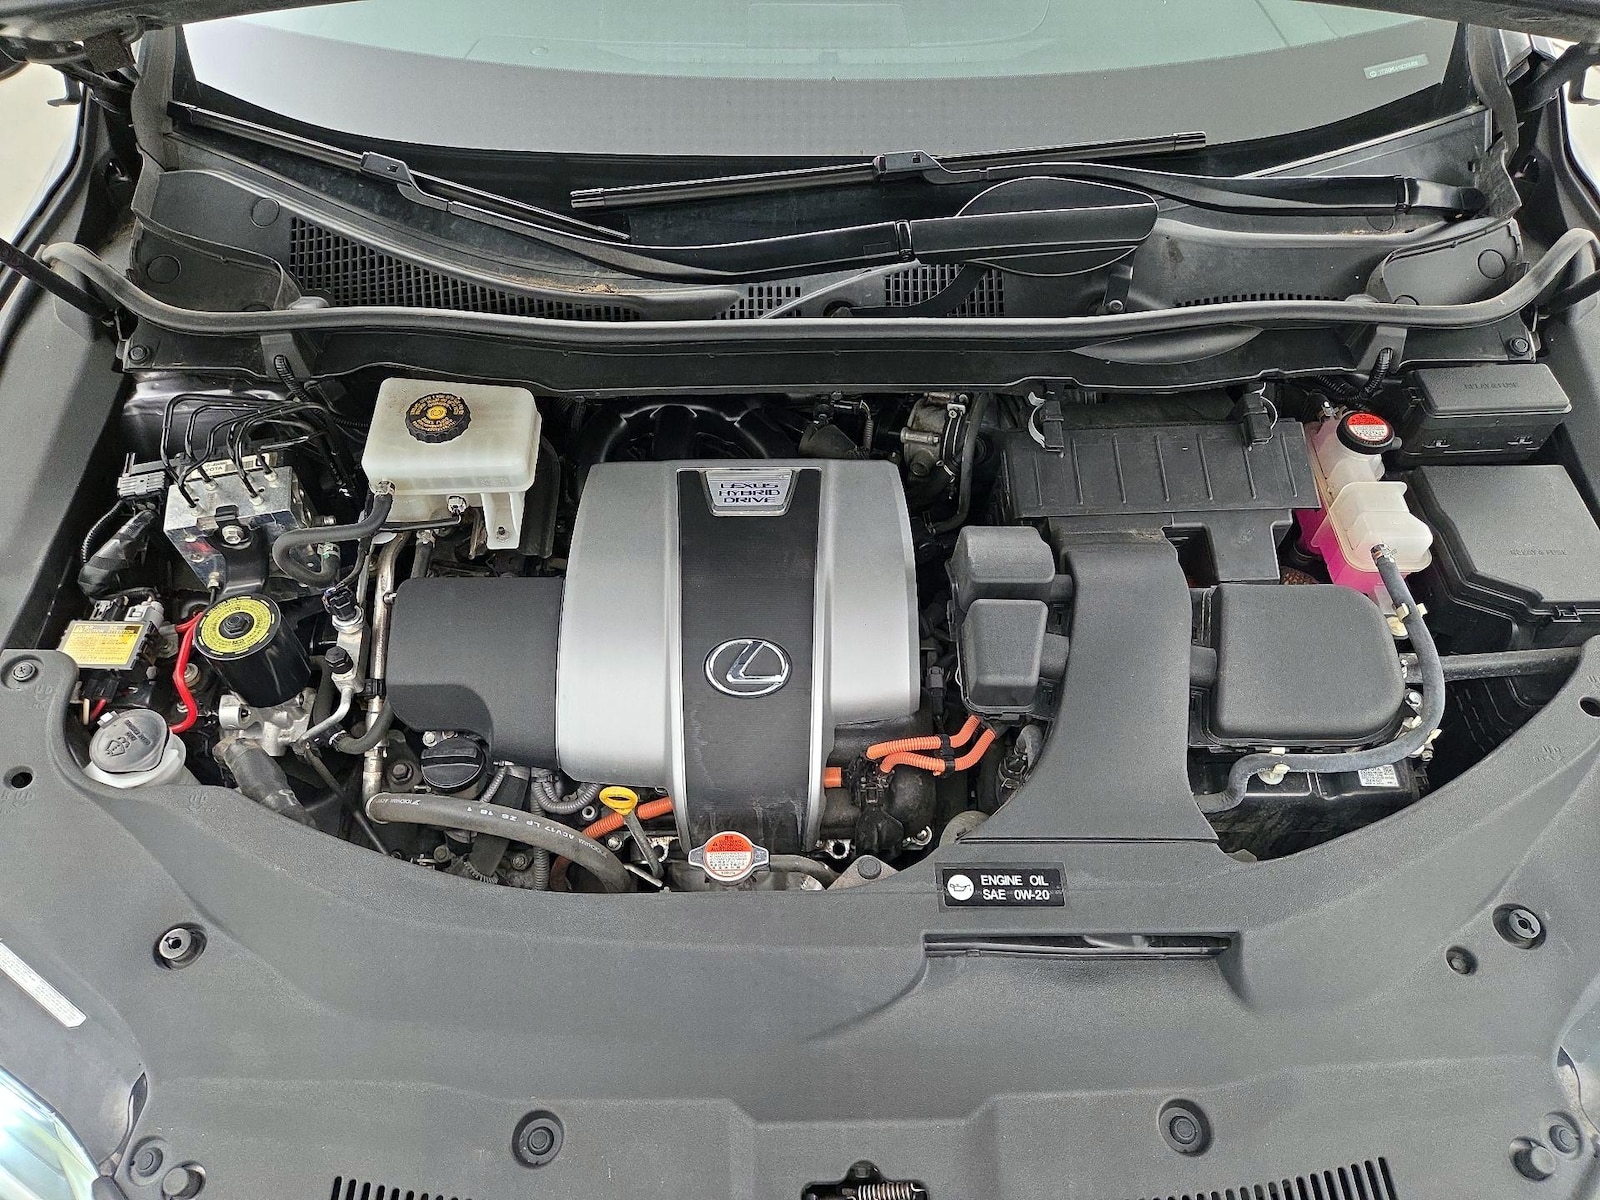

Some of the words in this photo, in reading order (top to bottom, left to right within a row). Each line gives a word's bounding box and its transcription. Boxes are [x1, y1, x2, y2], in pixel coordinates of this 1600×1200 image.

[719, 489, 781, 497] HYBRID
[980, 875, 1023, 886] ENGINE
[1029, 875, 1049, 886] OIL
[983, 889, 1007, 900] SAE
[1014, 889, 1050, 901] 0W-20
